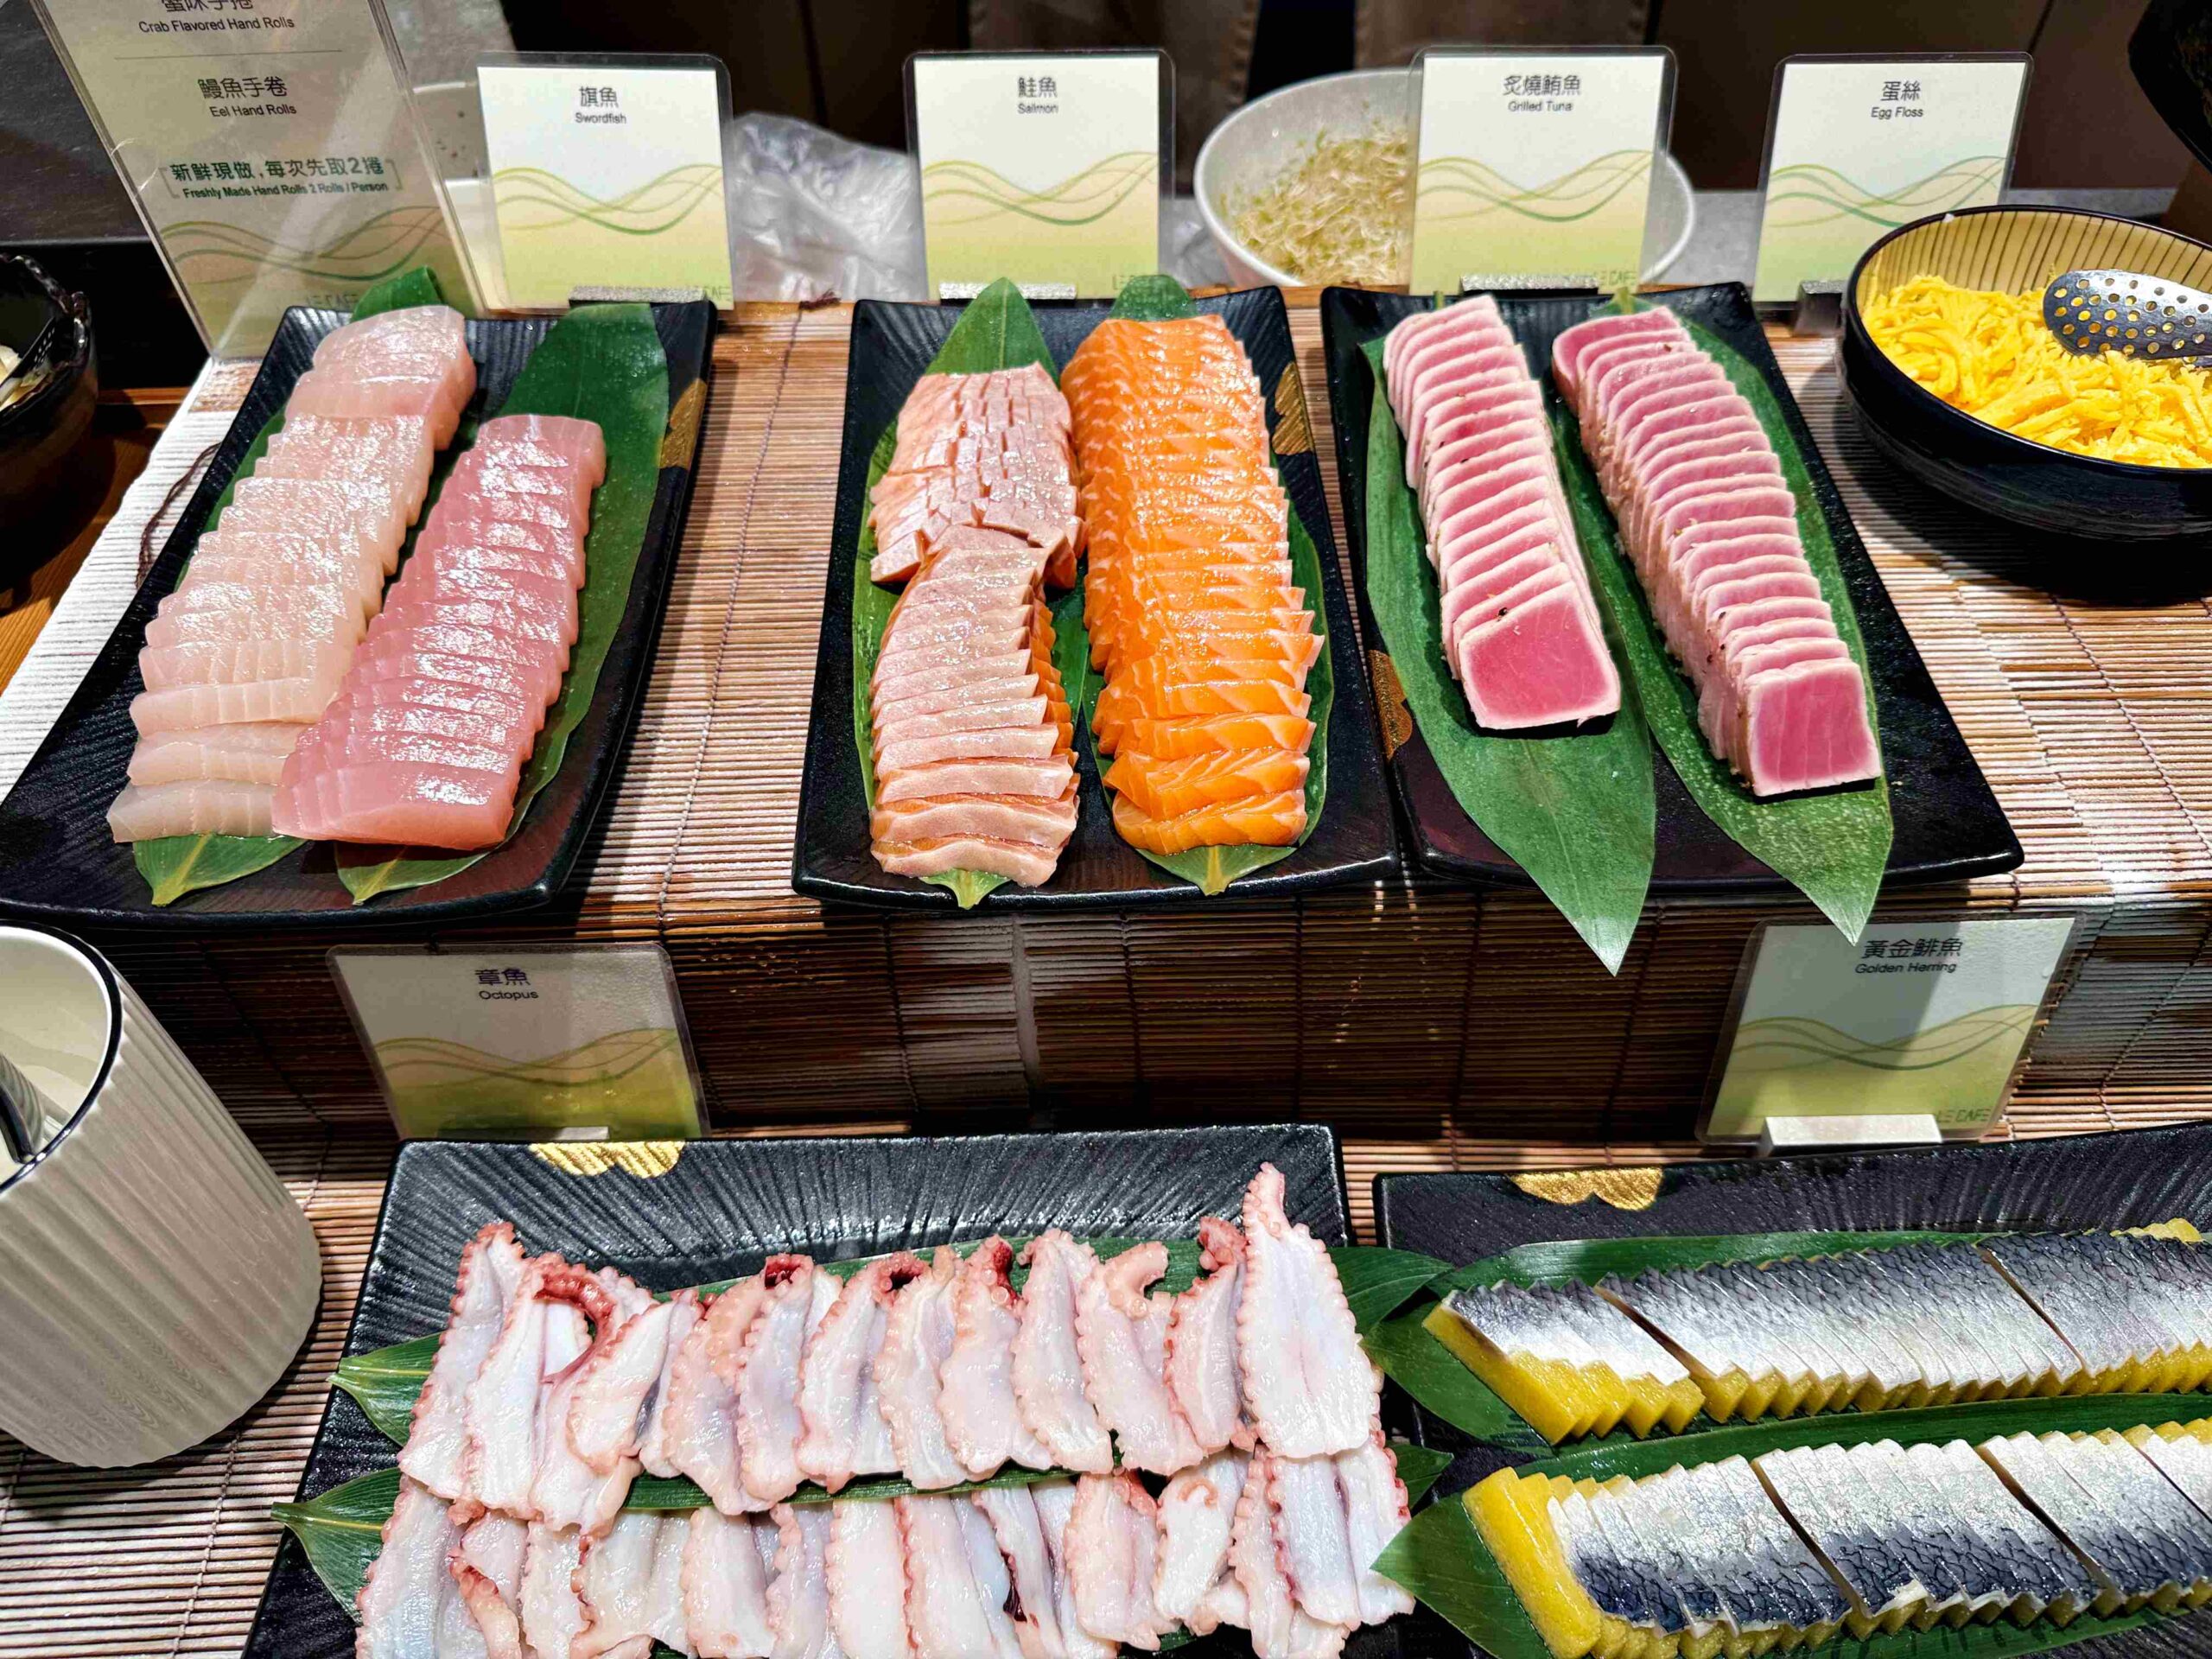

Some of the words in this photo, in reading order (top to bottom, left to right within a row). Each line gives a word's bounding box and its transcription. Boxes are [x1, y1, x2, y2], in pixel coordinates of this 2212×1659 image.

[138, 21, 169, 33] Crab
[172, 18, 225, 31] Flavored
[228, 17, 260, 29] Hand
[263, 16, 295, 29] Rolls
[197, 76, 288, 99] 鰻魚手卷
[1018, 77, 1058, 98] 鮭魚
[1503, 75, 1580, 96] 炙燒鮪魚
[1880, 80, 1921, 101] 蛋絲
[578, 86, 619, 108] 旗魚
[1508, 100, 1542, 111] Grilled
[1546, 100, 1573, 111] Tuna
[209, 105, 228, 118] Eel
[232, 105, 264, 117] Hand
[266, 103, 297, 115] Rolls
[1017, 102, 1059, 114] Salmon
[1871, 106, 1892, 120] Egg
[1895, 106, 1923, 118] Floss
[575, 112, 626, 124] Swordfish
[182, 188, 221, 200] Freshly
[222, 186, 251, 198] Made
[251, 185, 280, 196] Hand
[281, 184, 308, 194] Rolls
[308, 183, 317, 194] 2
[318, 182, 345, 194] Rolls
[351, 181, 389, 192] Person
[1861, 938, 1963, 959] 黃金鯡魚
[1855, 963, 1904, 974] Golden
[1907, 962, 1957, 974] Herring
[474, 969, 531, 986] 章魚
[479, 990, 539, 1001] Octopus
